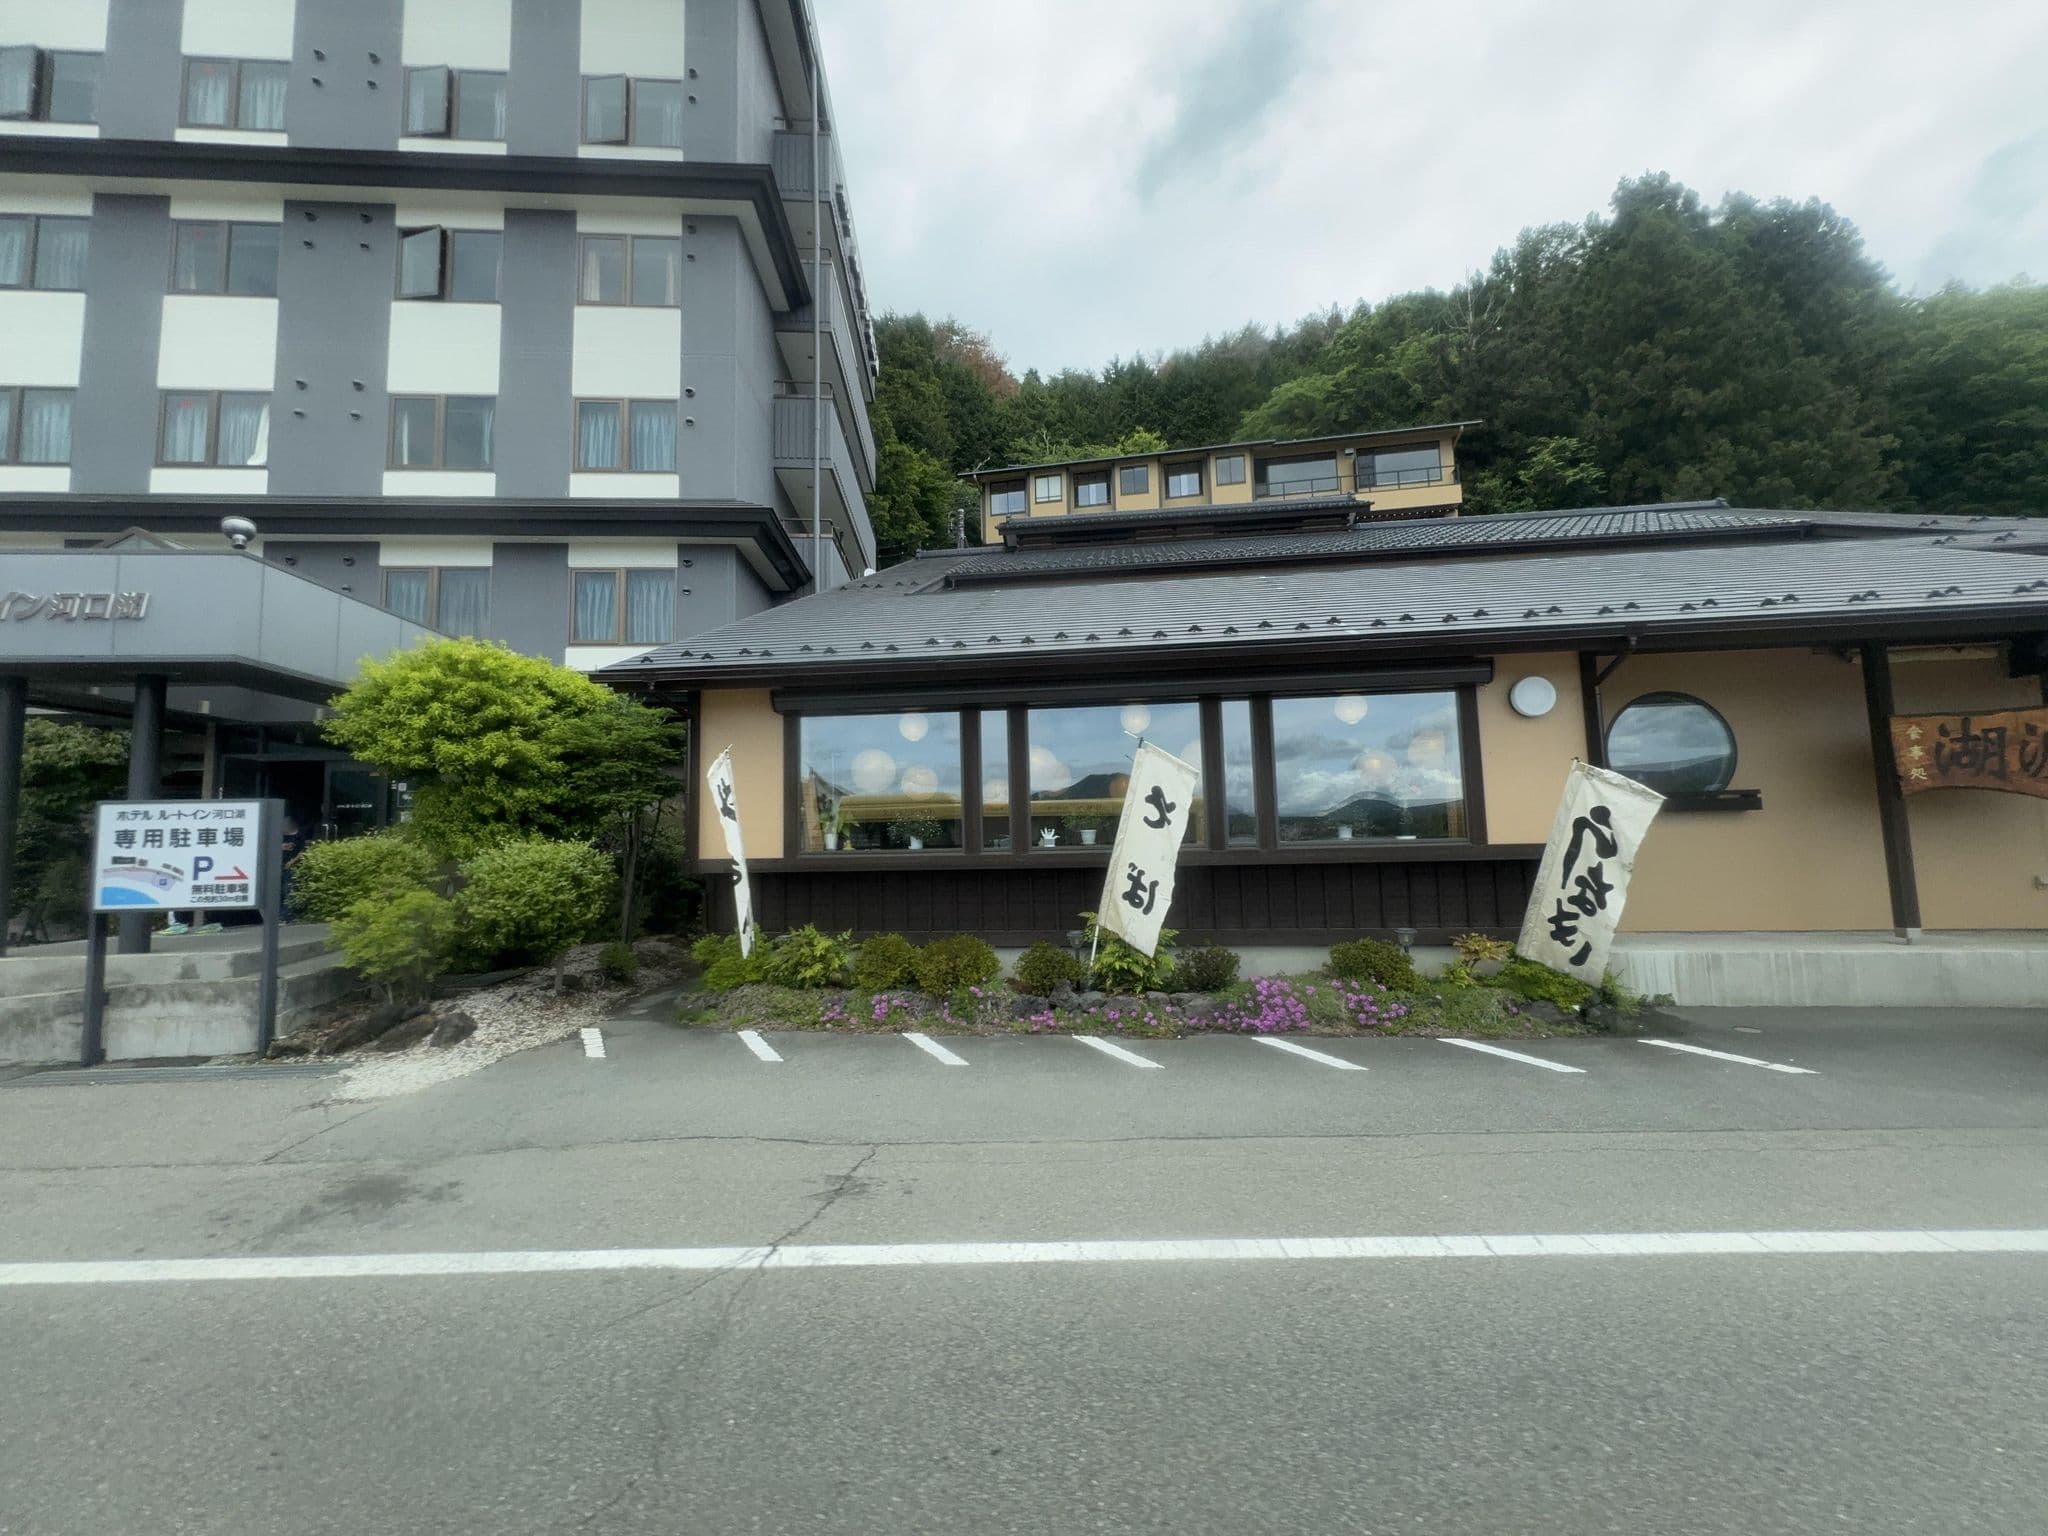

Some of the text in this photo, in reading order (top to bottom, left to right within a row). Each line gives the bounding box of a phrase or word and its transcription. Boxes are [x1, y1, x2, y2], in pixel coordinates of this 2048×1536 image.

[116, 810, 152, 821] ホテル
[114, 827, 245, 849] 専用駐車場
[193, 856, 214, 881] P
[191, 883, 249, 895] 無料駐車場
